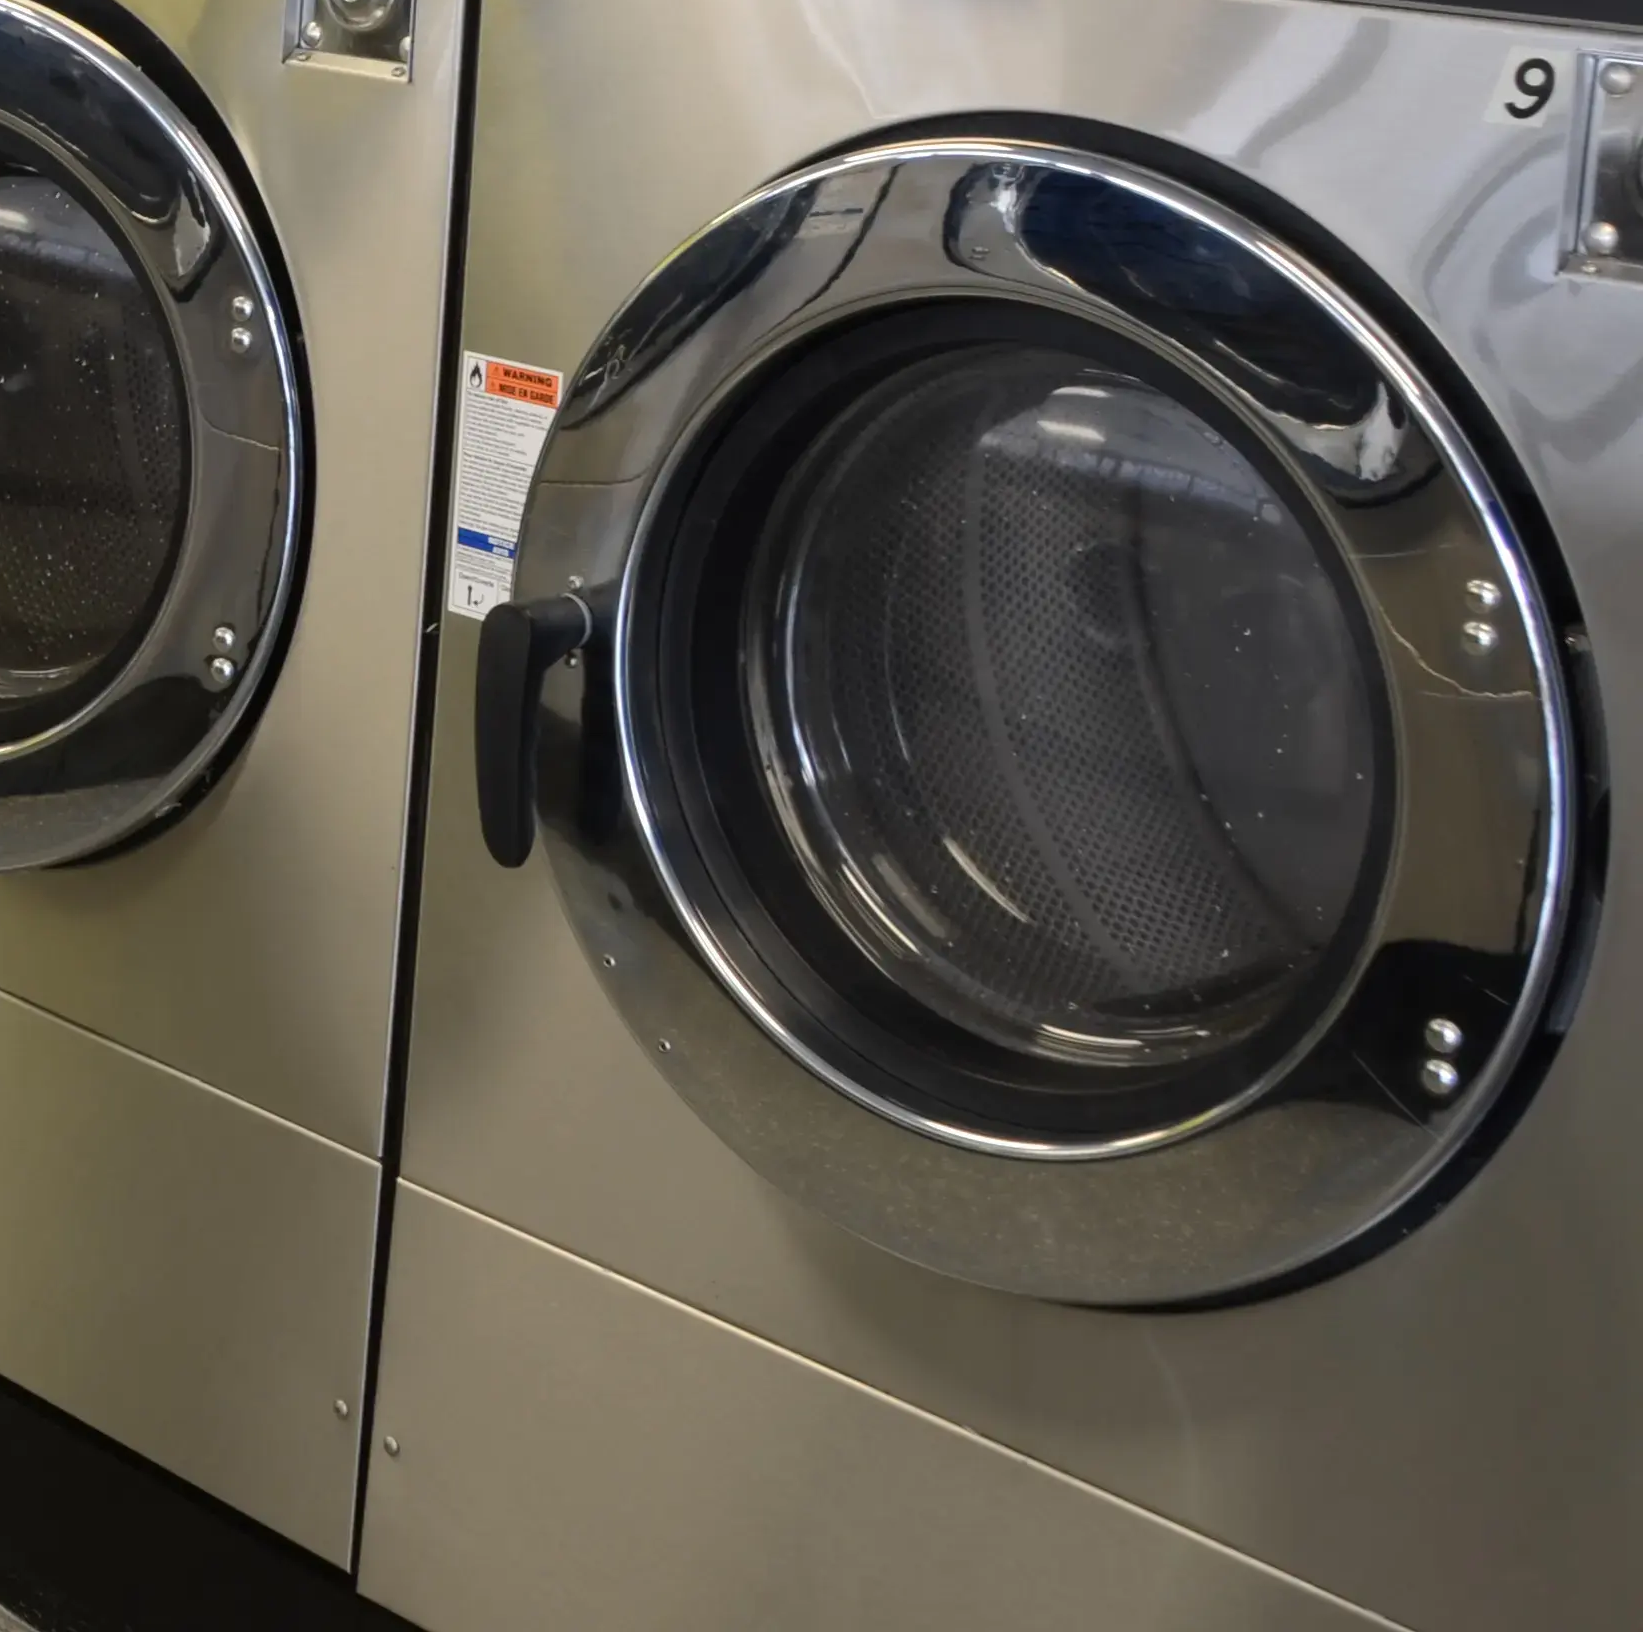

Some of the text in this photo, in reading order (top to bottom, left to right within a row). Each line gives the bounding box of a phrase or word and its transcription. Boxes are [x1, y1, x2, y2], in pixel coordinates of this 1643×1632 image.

[1504, 57, 1555, 119] 9
[502, 367, 553, 388] WARNING
[518, 388, 529, 399] EN
